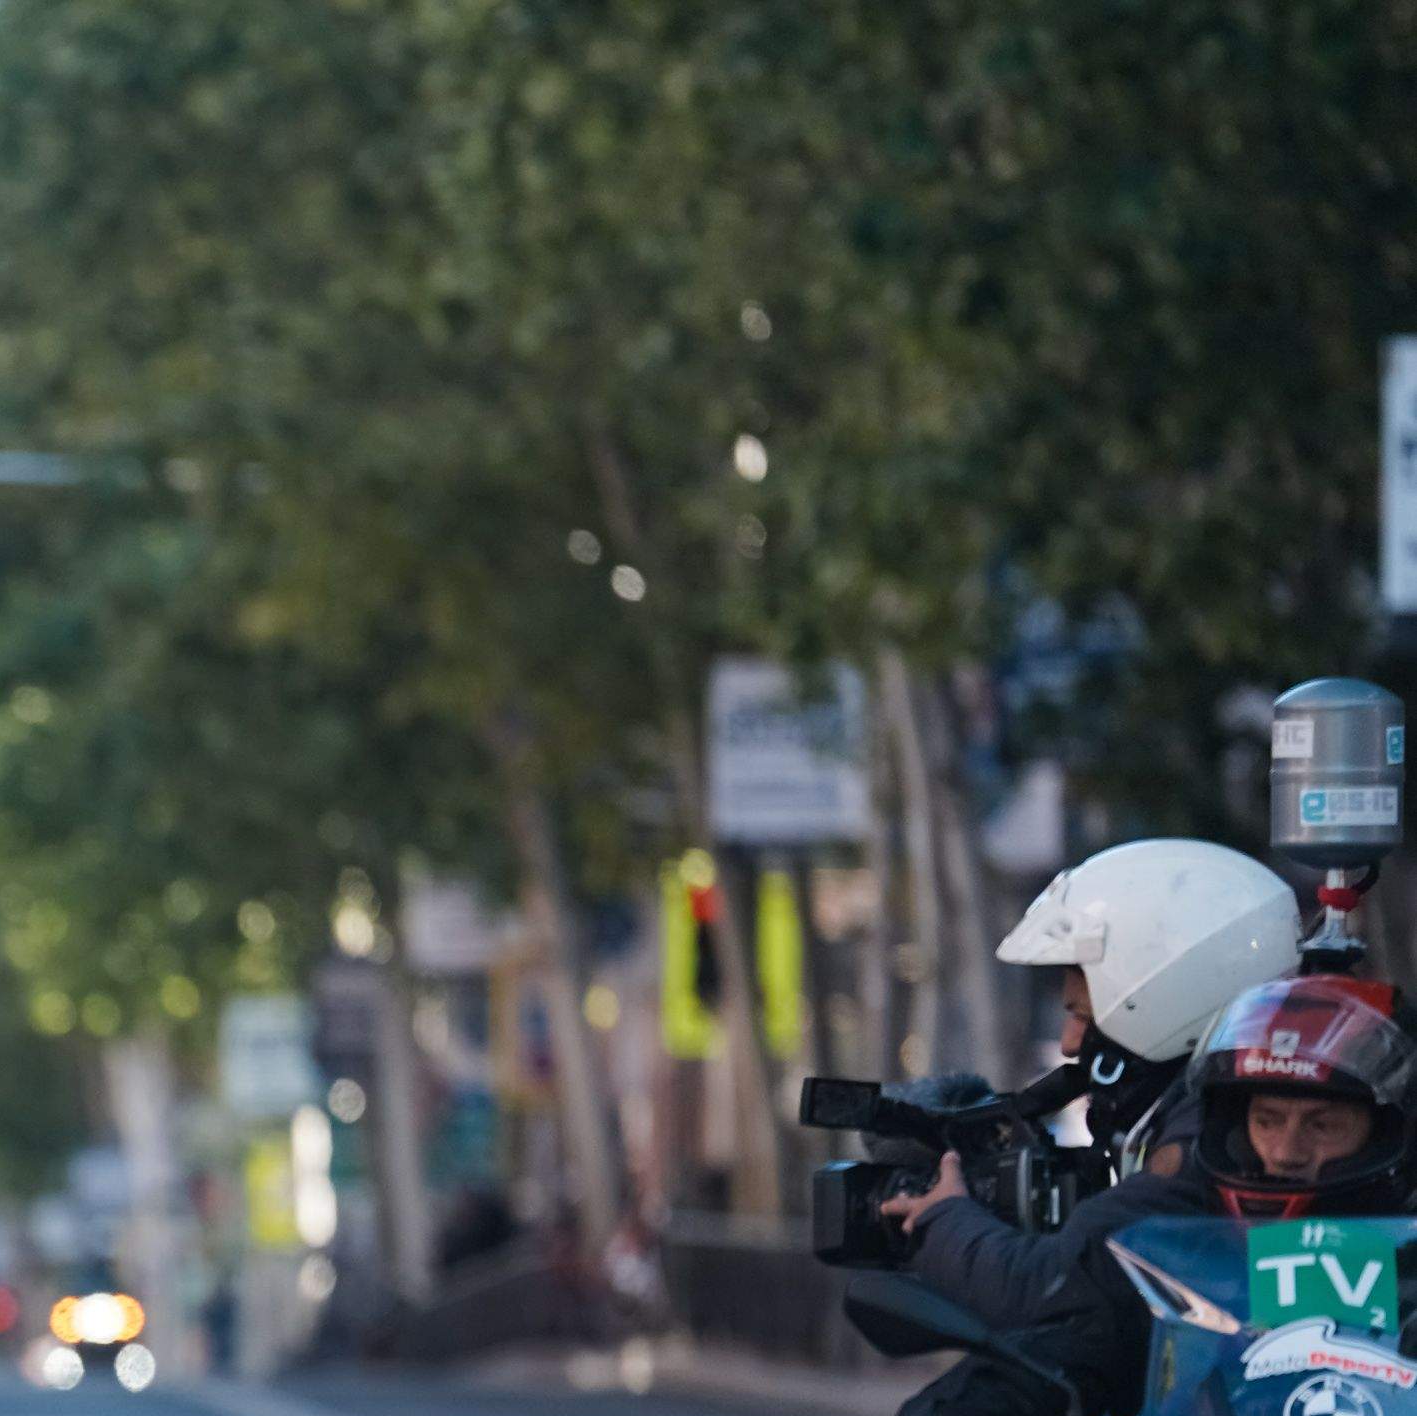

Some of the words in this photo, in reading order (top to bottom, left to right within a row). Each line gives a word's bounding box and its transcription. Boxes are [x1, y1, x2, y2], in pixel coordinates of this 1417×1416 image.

[1243, 1056, 1317, 1080] SHARK
[1255, 1252, 1384, 1308] TV
[1369, 1306, 1387, 1329] 2
